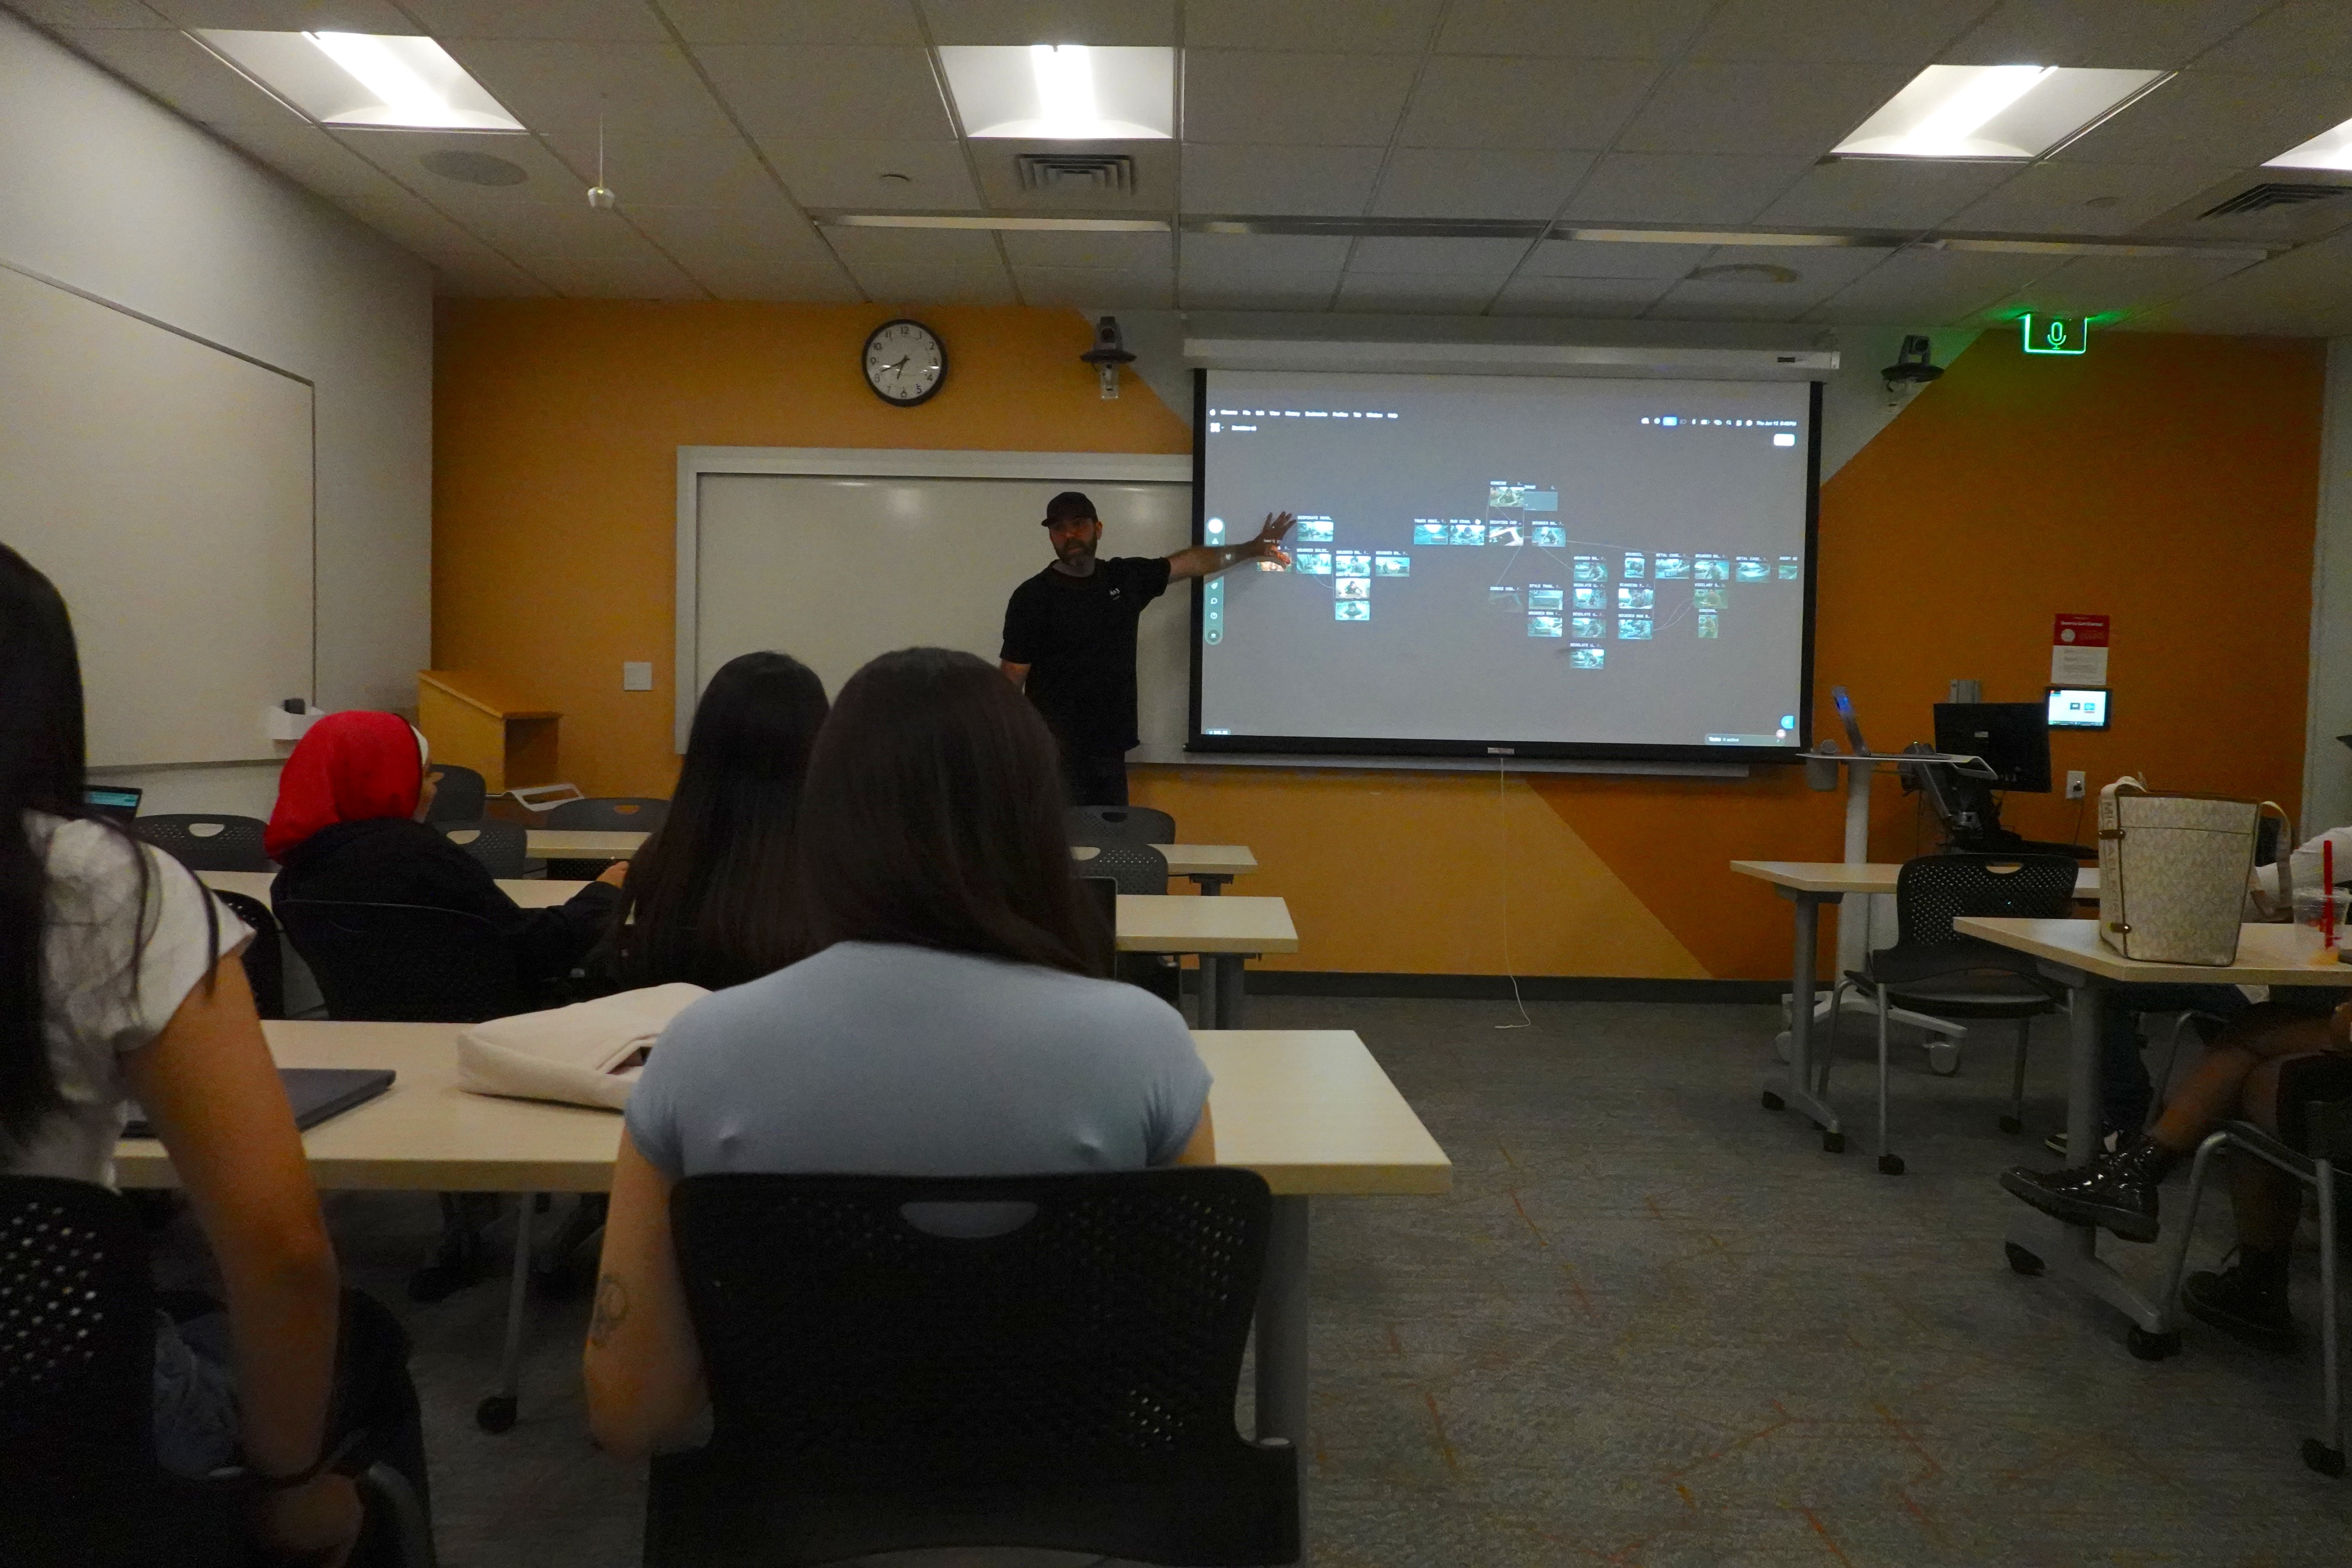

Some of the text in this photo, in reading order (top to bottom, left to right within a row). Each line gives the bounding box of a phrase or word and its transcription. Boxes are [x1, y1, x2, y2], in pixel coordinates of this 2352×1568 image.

[870, 357, 876, 365] 9
[874, 374, 880, 383] 8
[887, 386, 892, 394] 7
[900, 389, 907, 398] 6
[916, 385, 922, 394] 5
